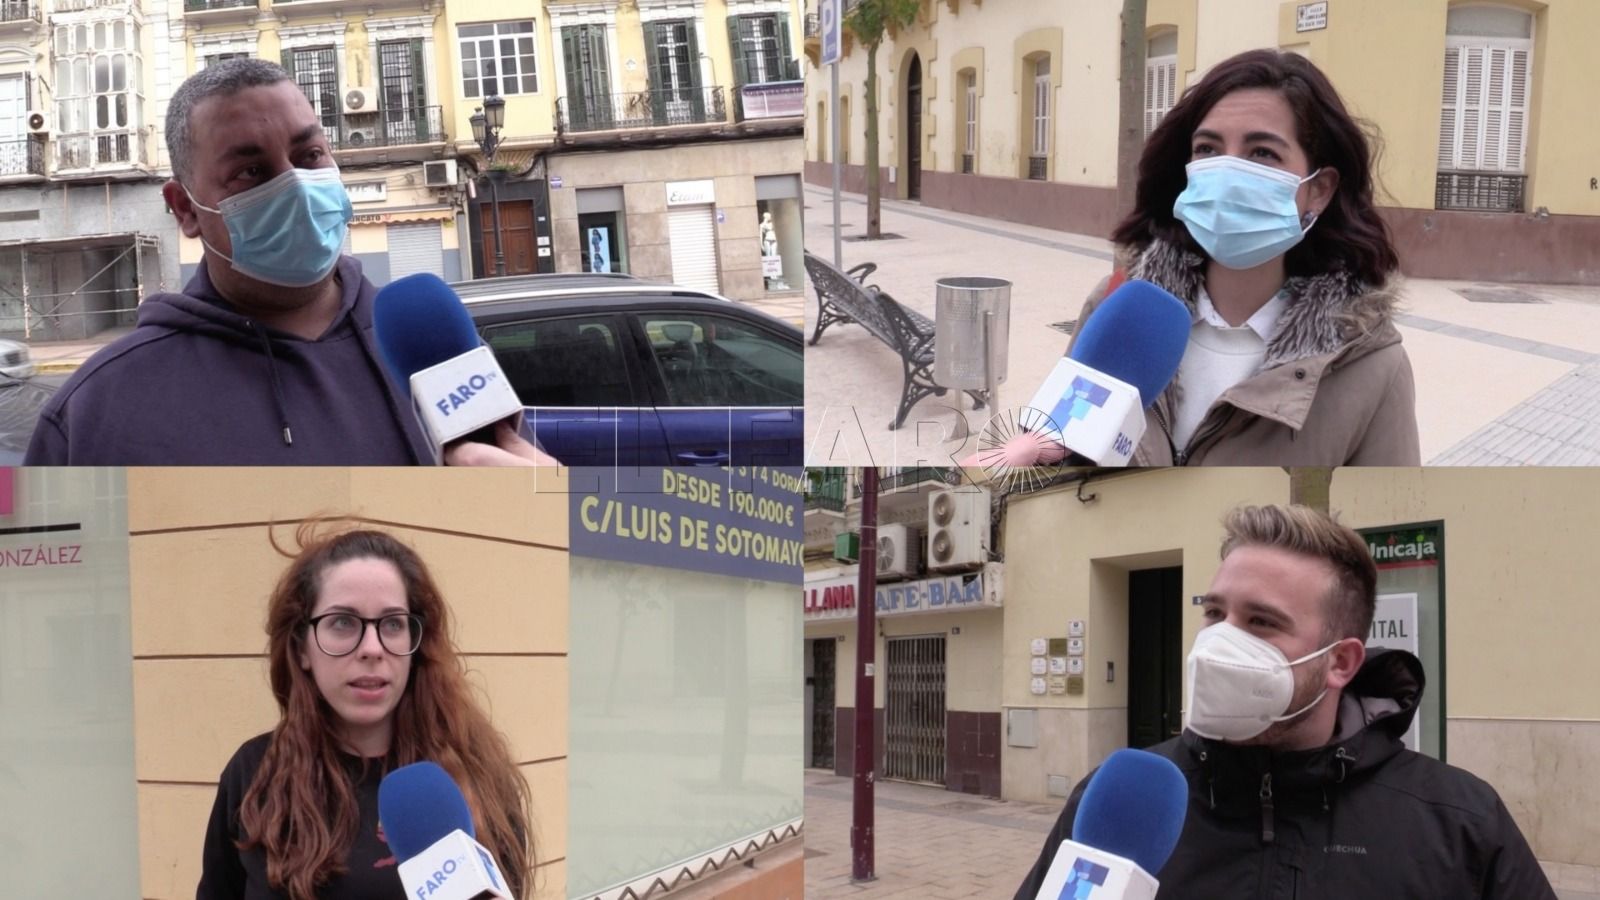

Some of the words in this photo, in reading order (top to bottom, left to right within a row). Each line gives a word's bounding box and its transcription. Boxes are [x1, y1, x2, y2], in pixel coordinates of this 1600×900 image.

[1590, 177, 1598, 190] R
[436, 374, 487, 417] FARO
[760, 466, 768, 483] 4
[662, 468, 721, 508] DESDE
[729, 488, 795, 528] 190.000€
[580, 495, 673, 545] C/LUIS
[680, 515, 709, 552] DE
[0, 543, 82, 568] NZÁLEZ
[876, 578, 984, 612] AFE-BAR
[416, 859, 457, 900] FARO
